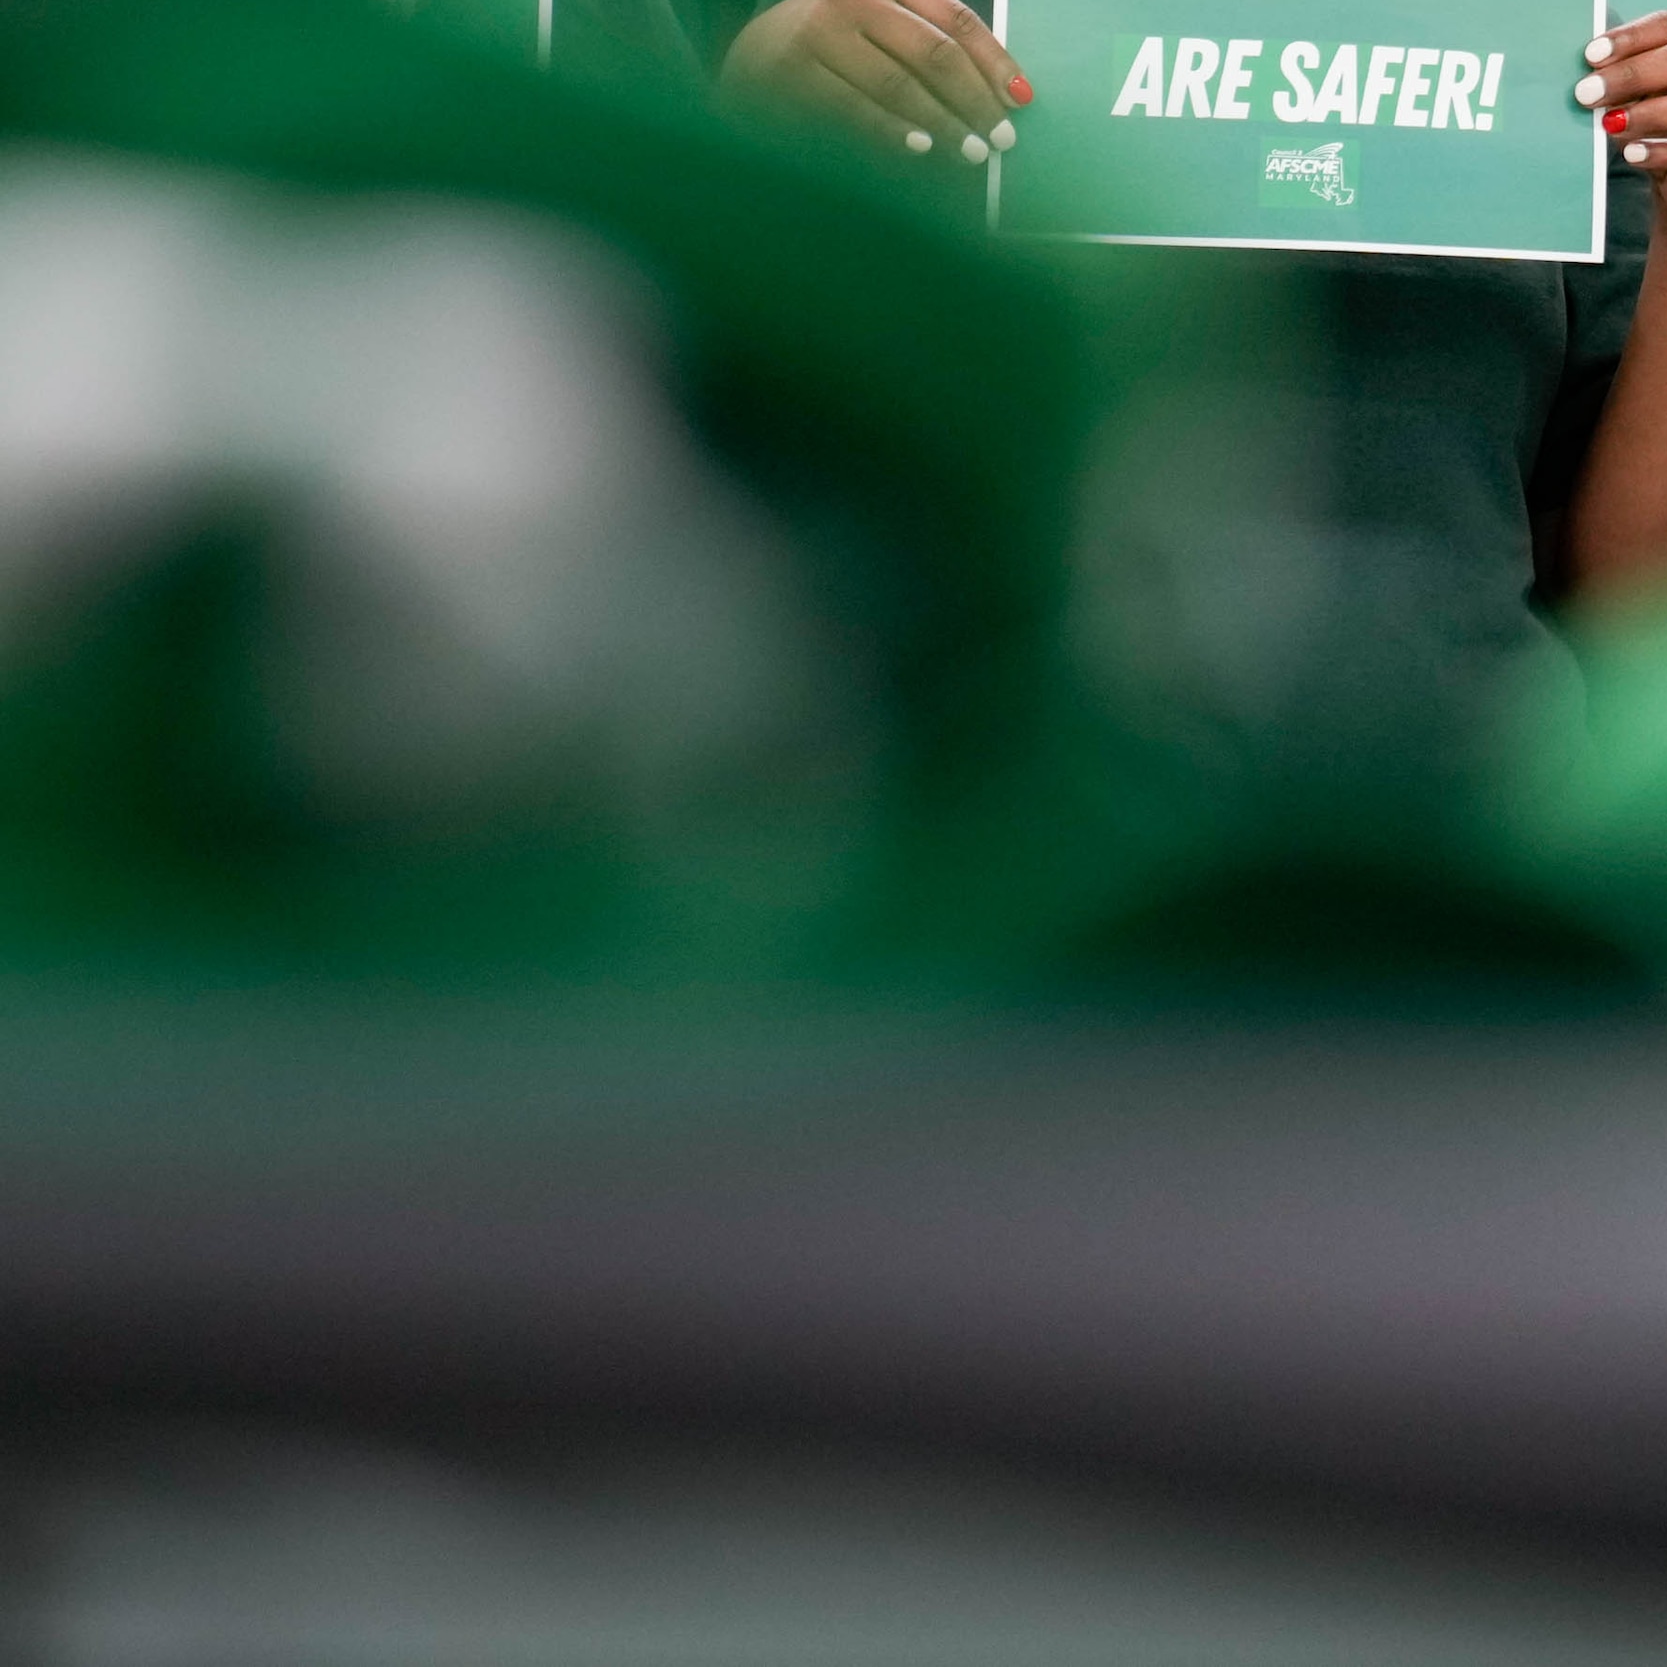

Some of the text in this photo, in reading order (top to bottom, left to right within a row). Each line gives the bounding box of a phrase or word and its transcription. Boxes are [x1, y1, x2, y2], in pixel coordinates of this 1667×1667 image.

[1111, 36, 1505, 132] ARE SAFER!
[1265, 157, 1340, 175] AFSCME
[1265, 174, 1340, 182] MARYLAND
